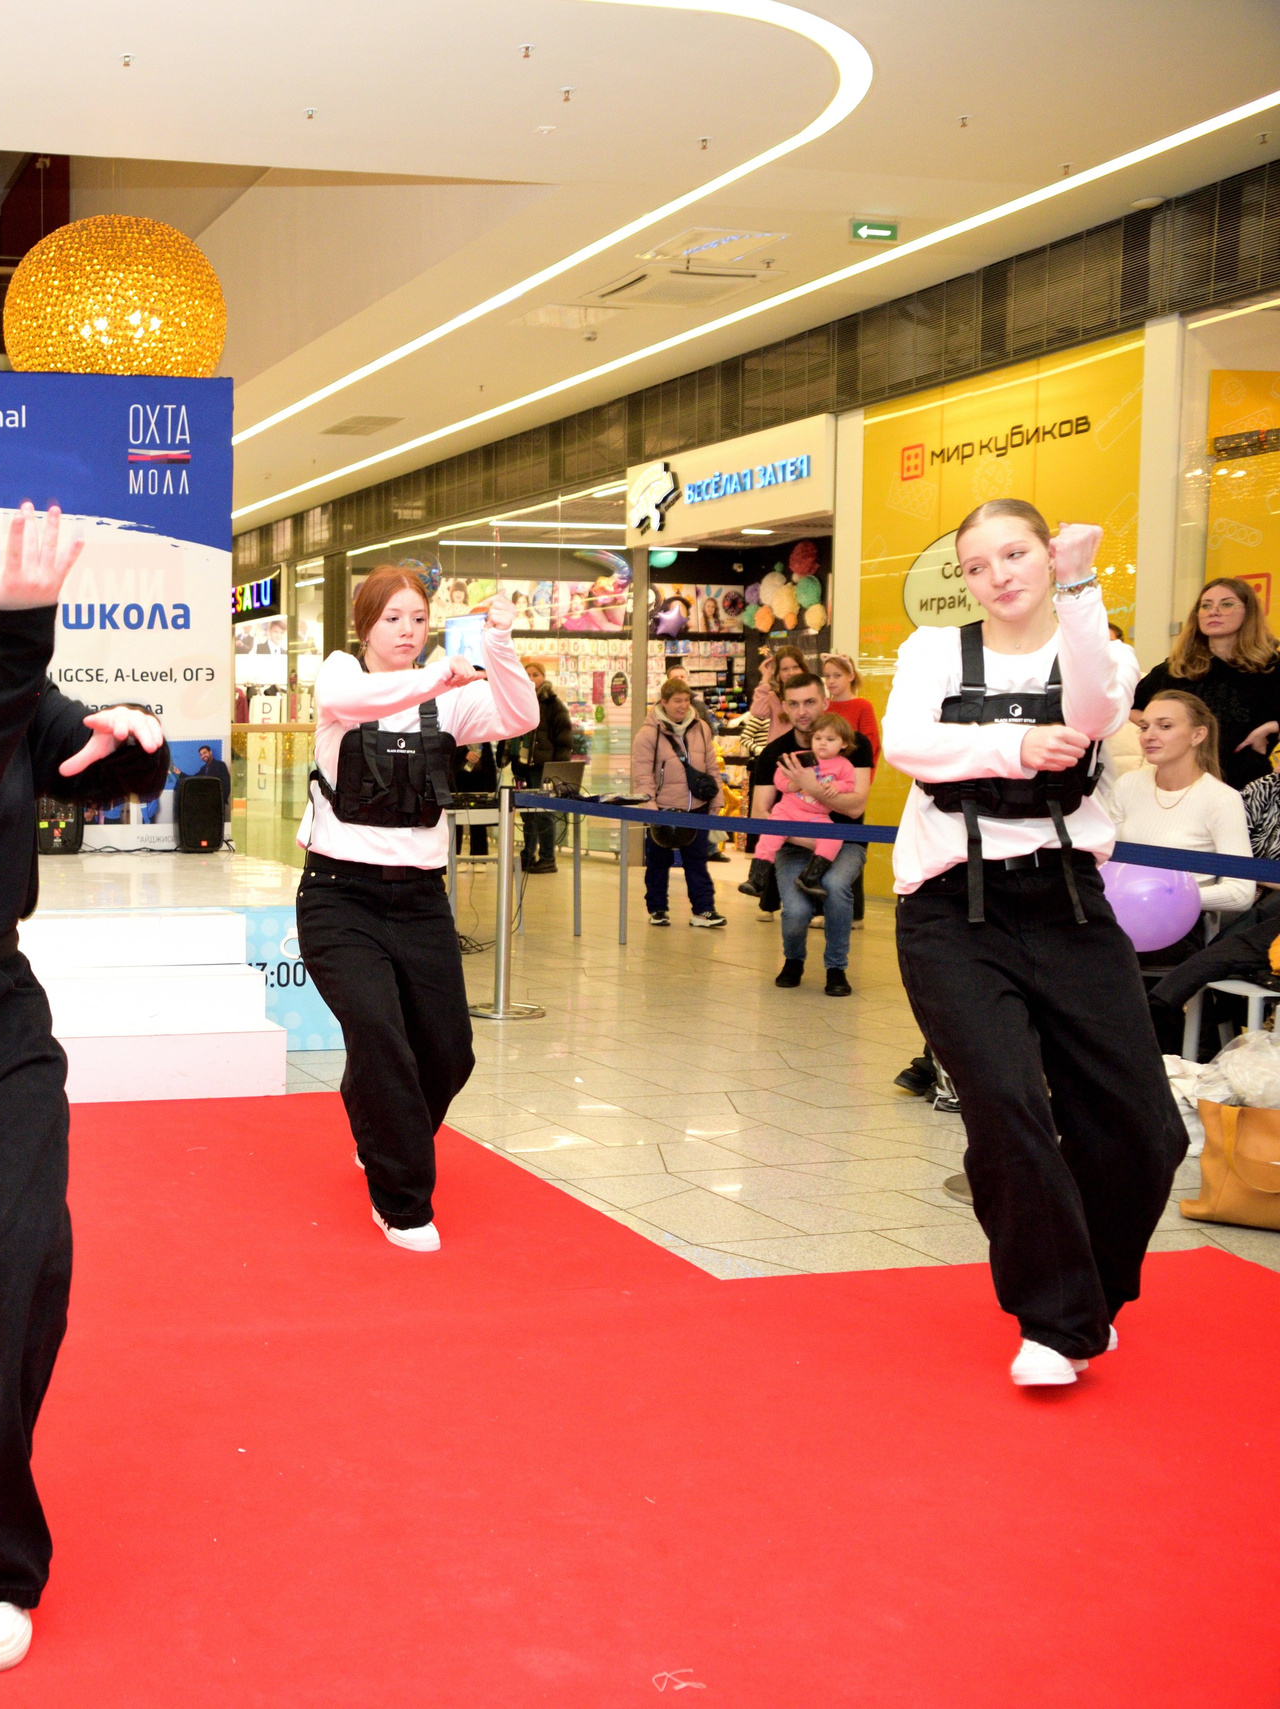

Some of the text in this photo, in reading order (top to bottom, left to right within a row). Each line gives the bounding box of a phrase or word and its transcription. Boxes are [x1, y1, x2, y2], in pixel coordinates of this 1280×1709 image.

[129, 404, 191, 444] ОХТА
[930, 415, 1092, 465] мир кубиков
[128, 469, 190, 495] МОЛЛ
[755, 454, 810, 489] ЗАТЕЯ
[919, 587, 972, 615] играй,
[62, 602, 191, 630] школа
[58, 668, 109, 683] IGCSE,
[114, 668, 179, 683] A-Level,
[183, 668, 216, 682] ОГЭ
